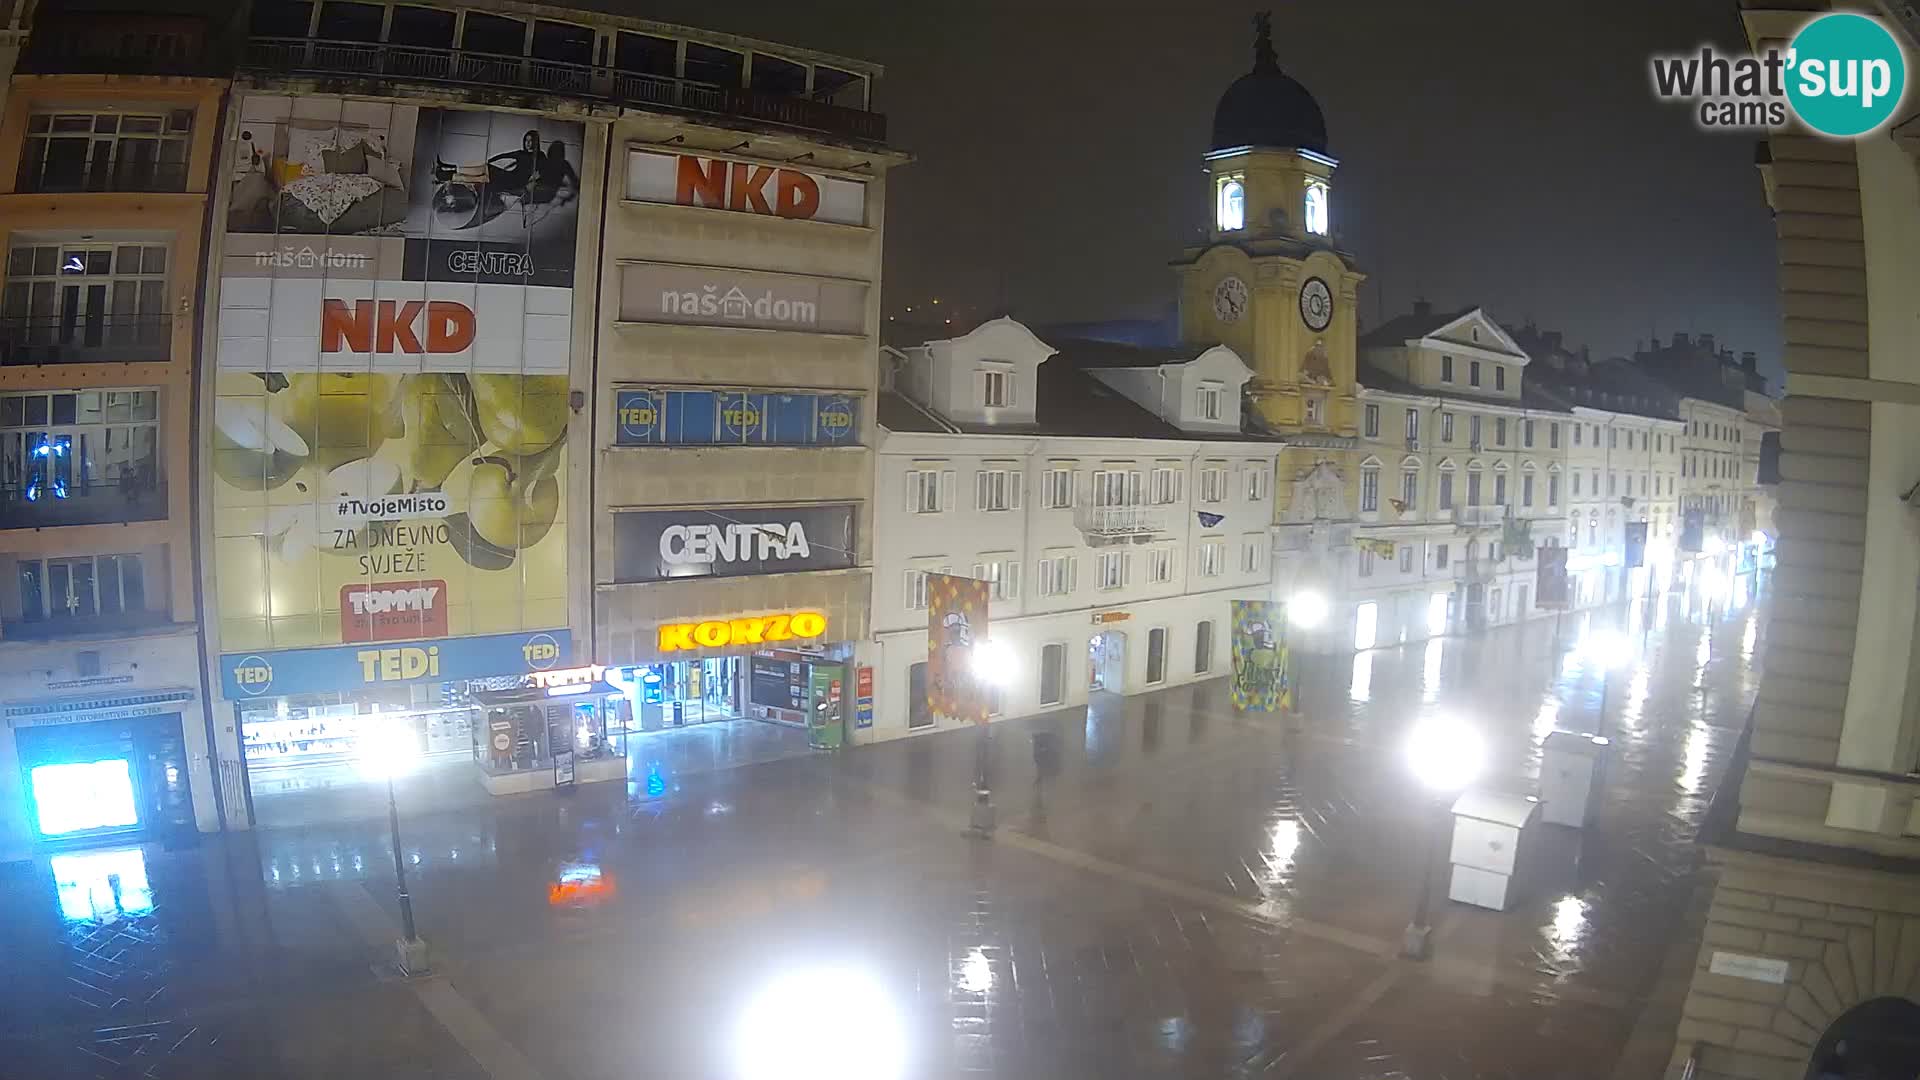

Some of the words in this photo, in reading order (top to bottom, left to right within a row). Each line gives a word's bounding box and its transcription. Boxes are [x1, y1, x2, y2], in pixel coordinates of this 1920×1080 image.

[676, 154, 820, 219] NKD
[255, 246, 296, 268] naš
[319, 247, 366, 269] dom
[447, 250, 535, 276] CENTRA
[661, 284, 719, 316] naš
[754, 291, 816, 322] dom
[320, 298, 477, 354] NKD
[619, 407, 657, 426] TEDi
[337, 496, 447, 518] #TvojeMisto
[333, 528, 357, 550] ZA
[367, 523, 451, 548] DNEVNO
[659, 521, 810, 564] CENTRA
[358, 547, 426, 576] SVJEŽE
[348, 587, 440, 615] TOMMY
[658, 611, 827, 653] KORZO
[358, 645, 440, 682] TEDi
[521, 642, 560, 662] TEDi
[233, 664, 274, 685] TEDi
